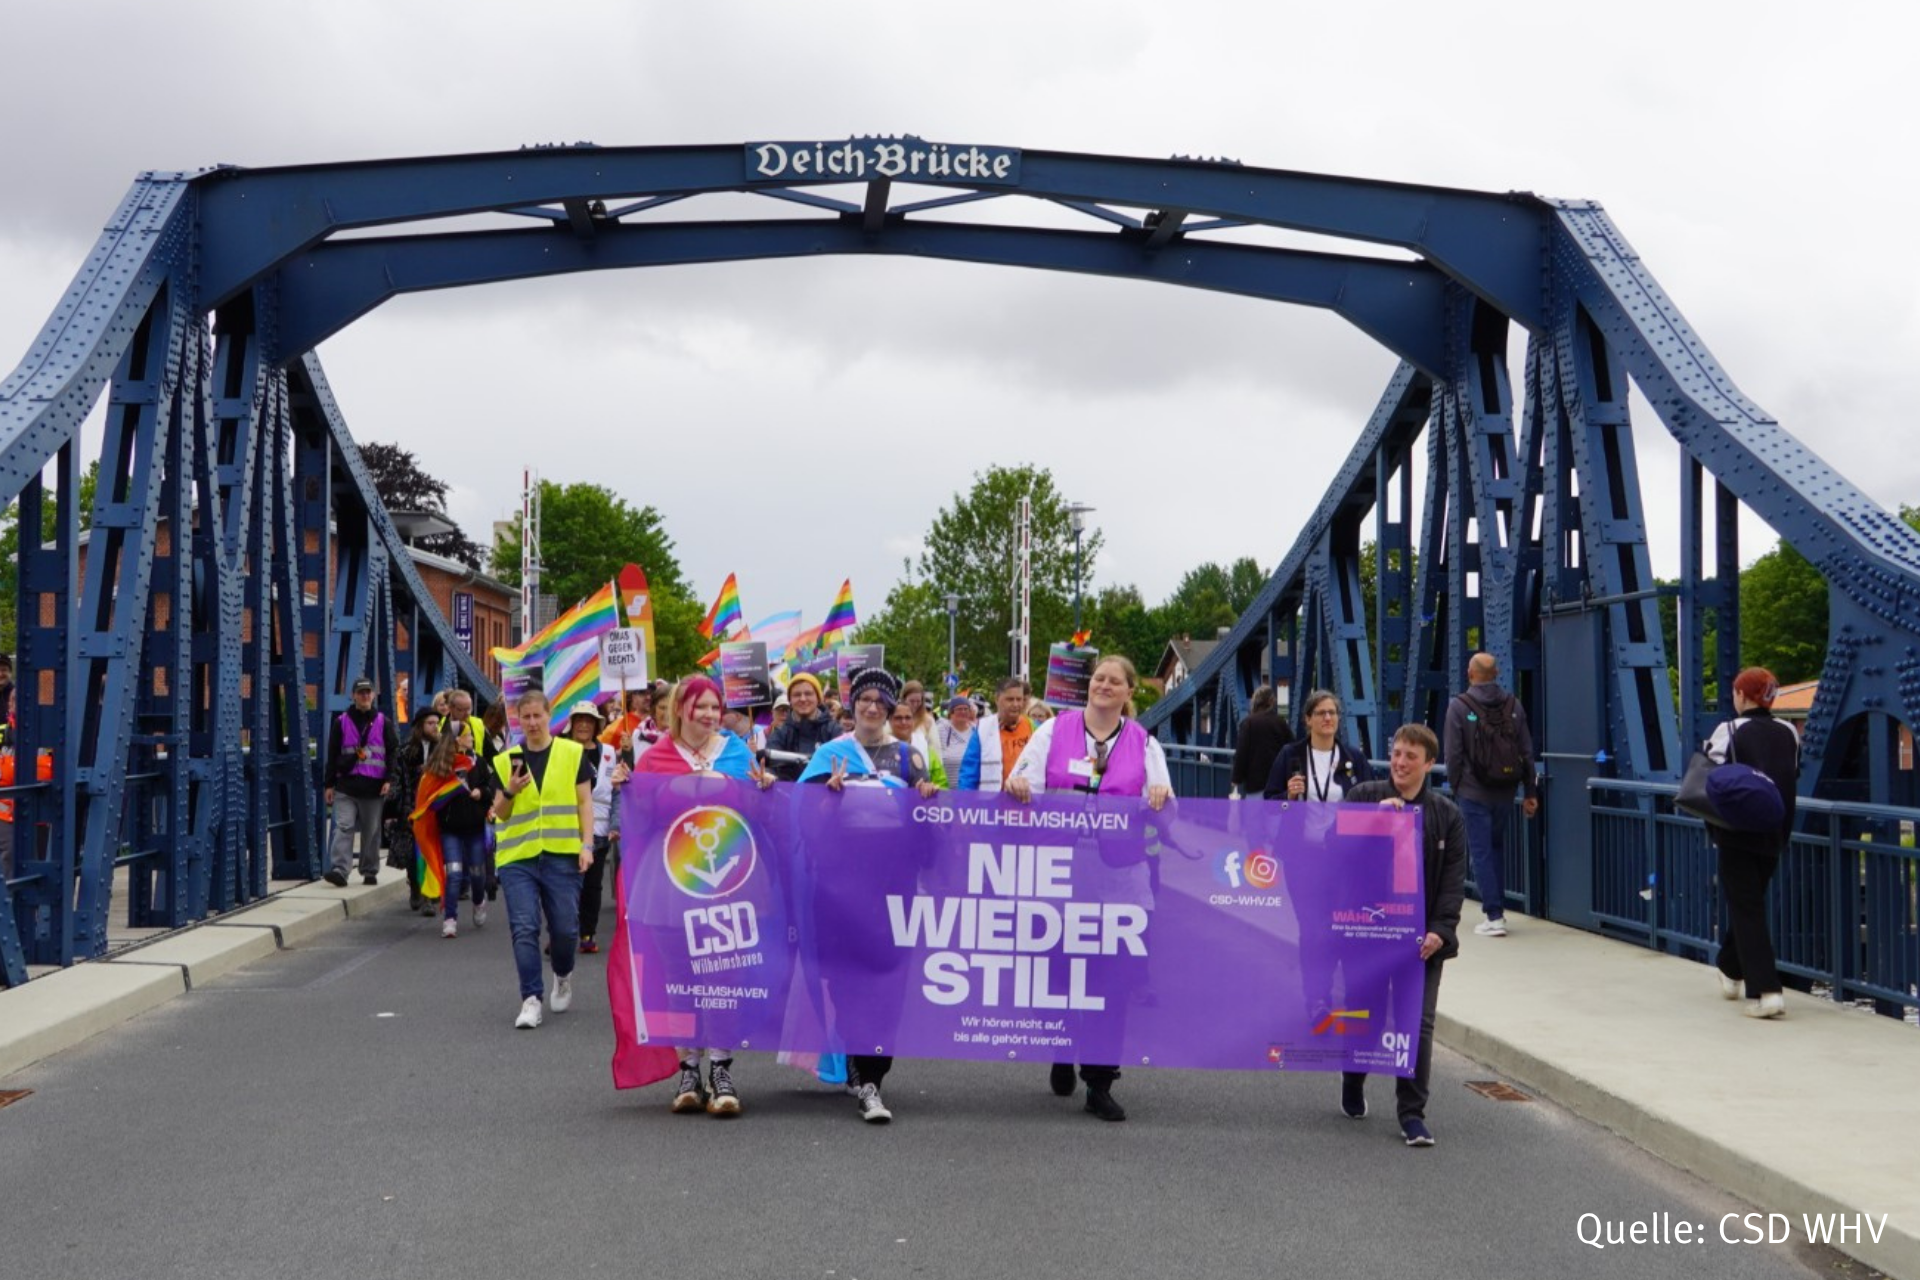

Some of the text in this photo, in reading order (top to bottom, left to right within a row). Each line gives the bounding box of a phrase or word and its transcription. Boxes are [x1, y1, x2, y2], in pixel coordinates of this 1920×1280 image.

[756, 142, 1012, 178] Deich-Brücke
[609, 630, 630, 642] OMAS
[608, 642, 633, 653] GEGEN
[608, 654, 636, 666] RECHTS
[912, 806, 1128, 830] CSD WILHELMSHAVEN
[968, 842, 1073, 898] NIE
[1209, 894, 1282, 907] CSD-WHV.DE
[683, 900, 760, 957] CSD
[886, 895, 1148, 956] WIEDER
[690, 951, 763, 976] Wilhelmshaven
[922, 951, 1105, 1010] STILL
[665, 983, 769, 999] WILHELMSHAVEN
[694, 997, 738, 1010] L(I)EBT!
[961, 1016, 1066, 1032] Wir hören nicht auf,
[953, 1031, 1072, 1047] bis alle gehört werden
[1381, 1032, 1410, 1051] QN
